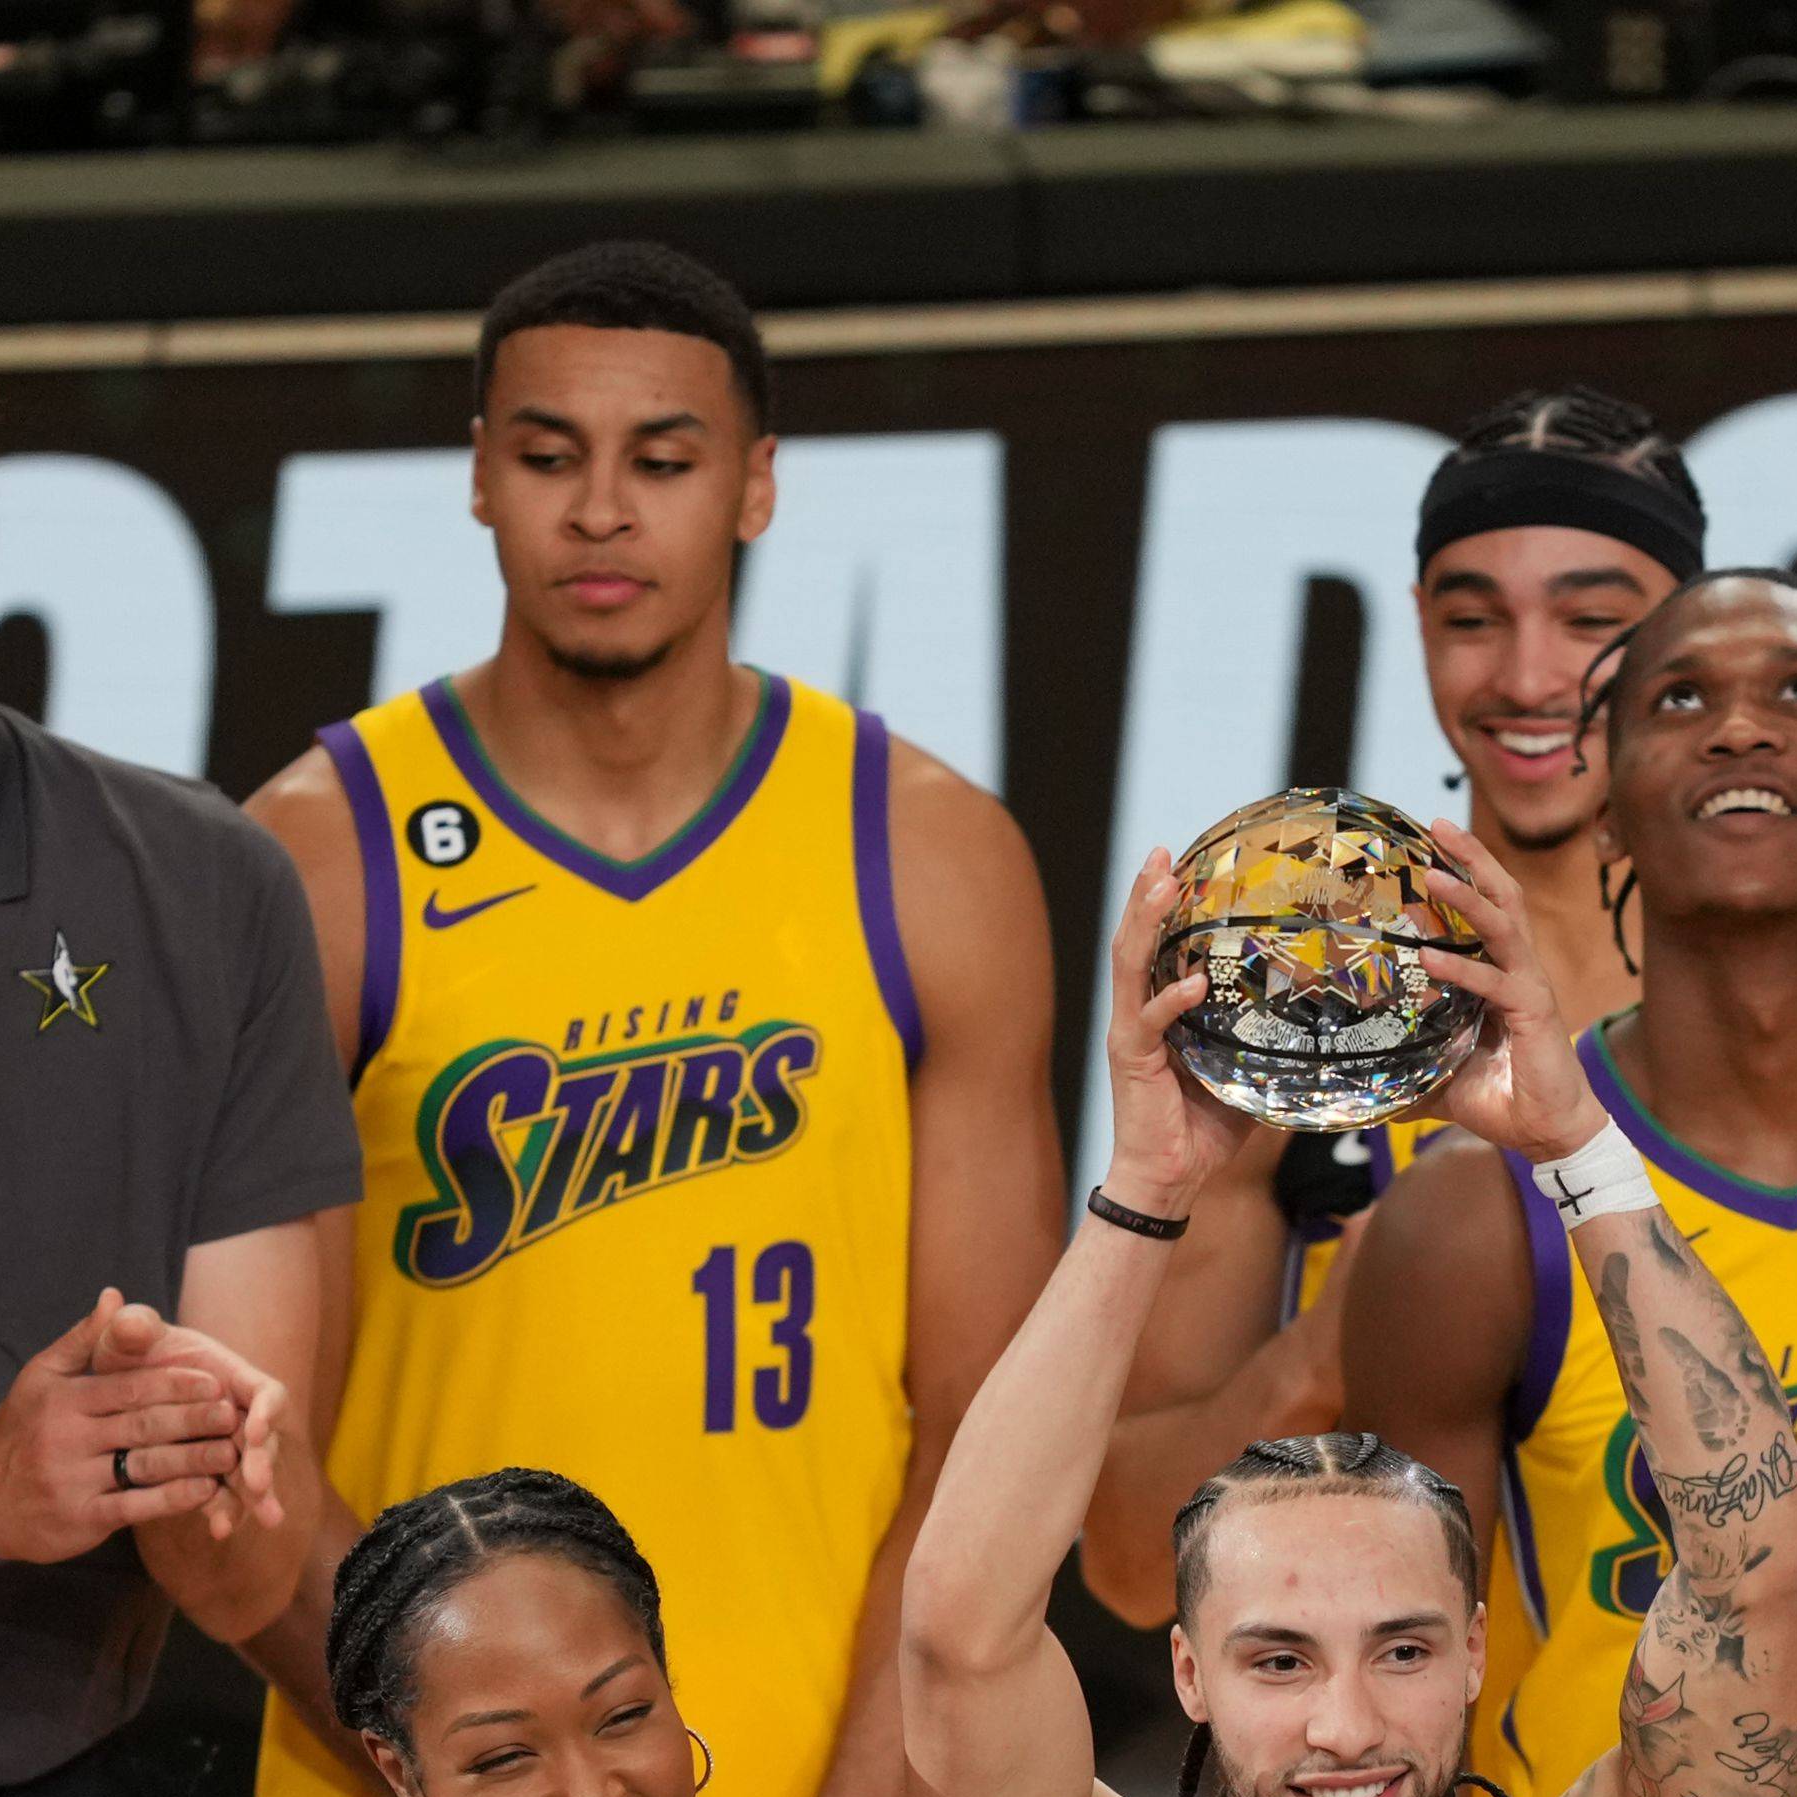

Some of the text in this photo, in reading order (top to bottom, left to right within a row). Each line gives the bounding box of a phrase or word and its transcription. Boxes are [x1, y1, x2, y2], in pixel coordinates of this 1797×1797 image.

[422, 807, 466, 863] 6
[564, 989, 739, 1049] RISING
[393, 1020, 823, 1289] STARS
[692, 1241, 816, 1433] 13
